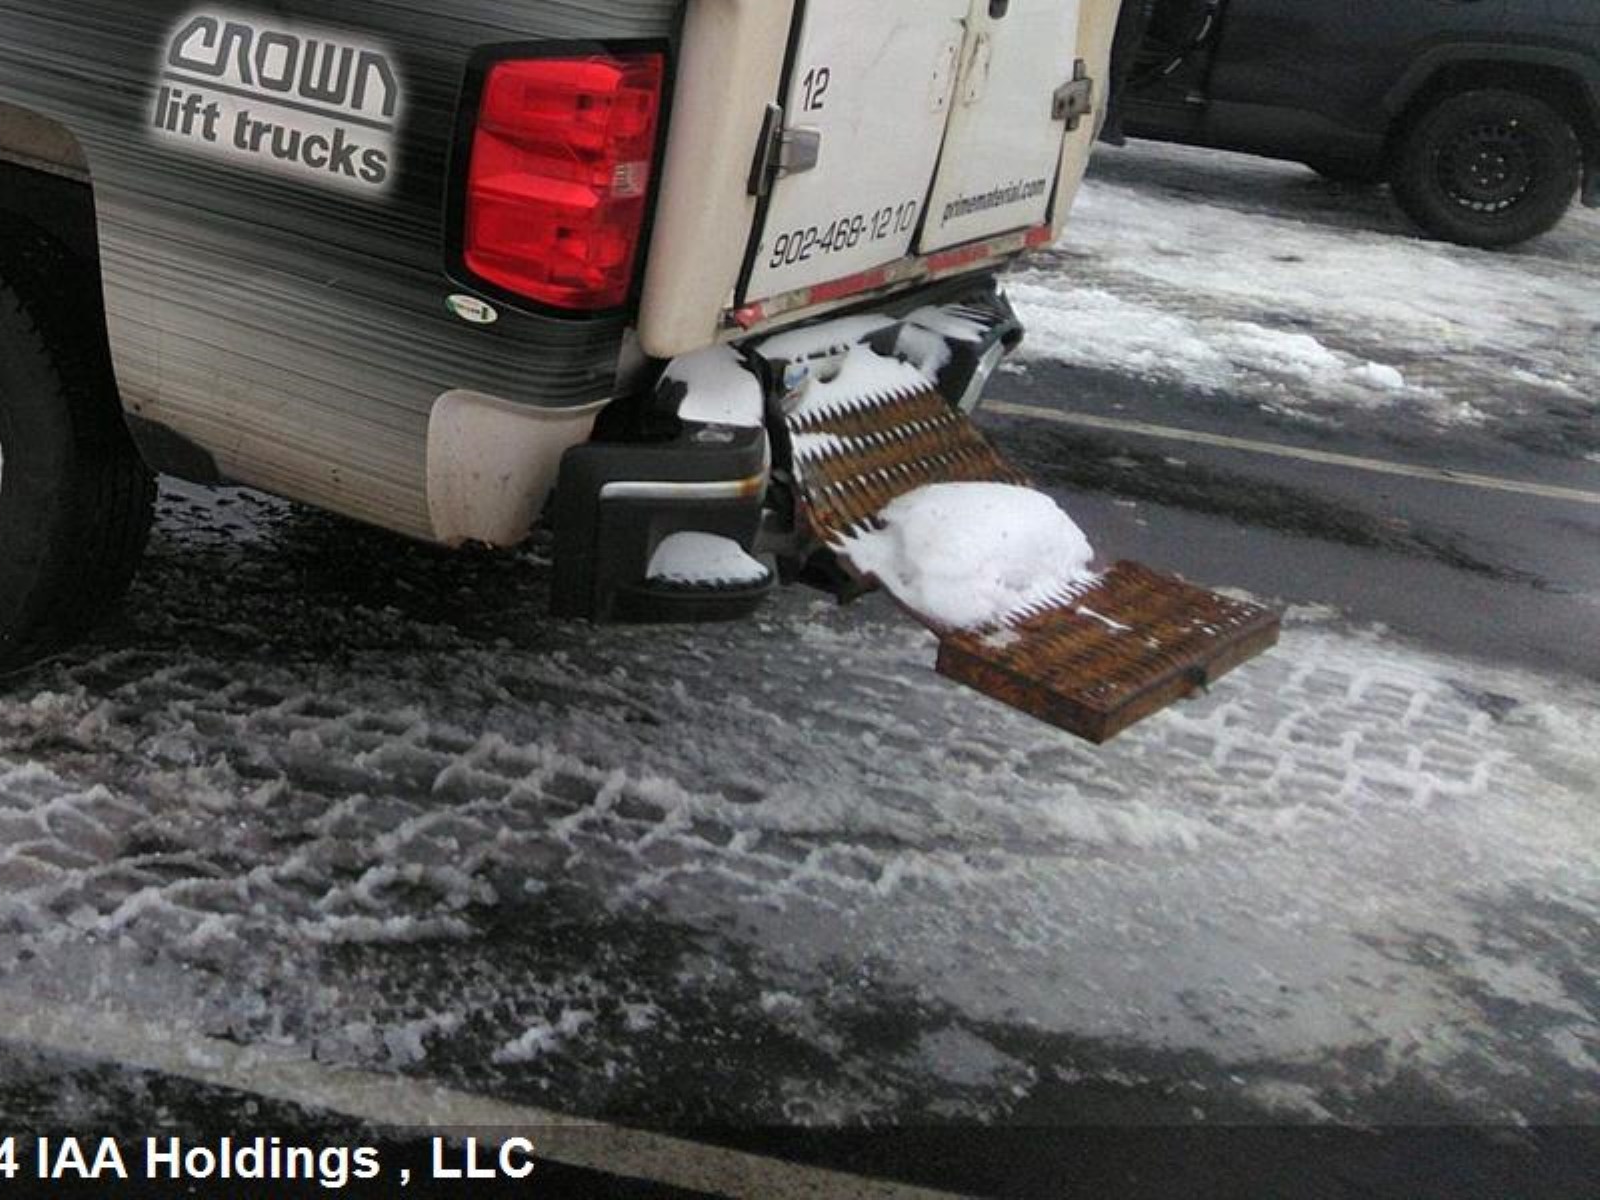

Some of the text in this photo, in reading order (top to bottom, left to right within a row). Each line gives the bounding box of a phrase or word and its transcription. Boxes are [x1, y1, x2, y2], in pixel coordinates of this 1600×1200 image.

[167, 14, 398, 117] CROWN
[803, 66, 831, 111] 12
[154, 85, 389, 186] lift trucks
[940, 177, 1047, 228] primematerial.com
